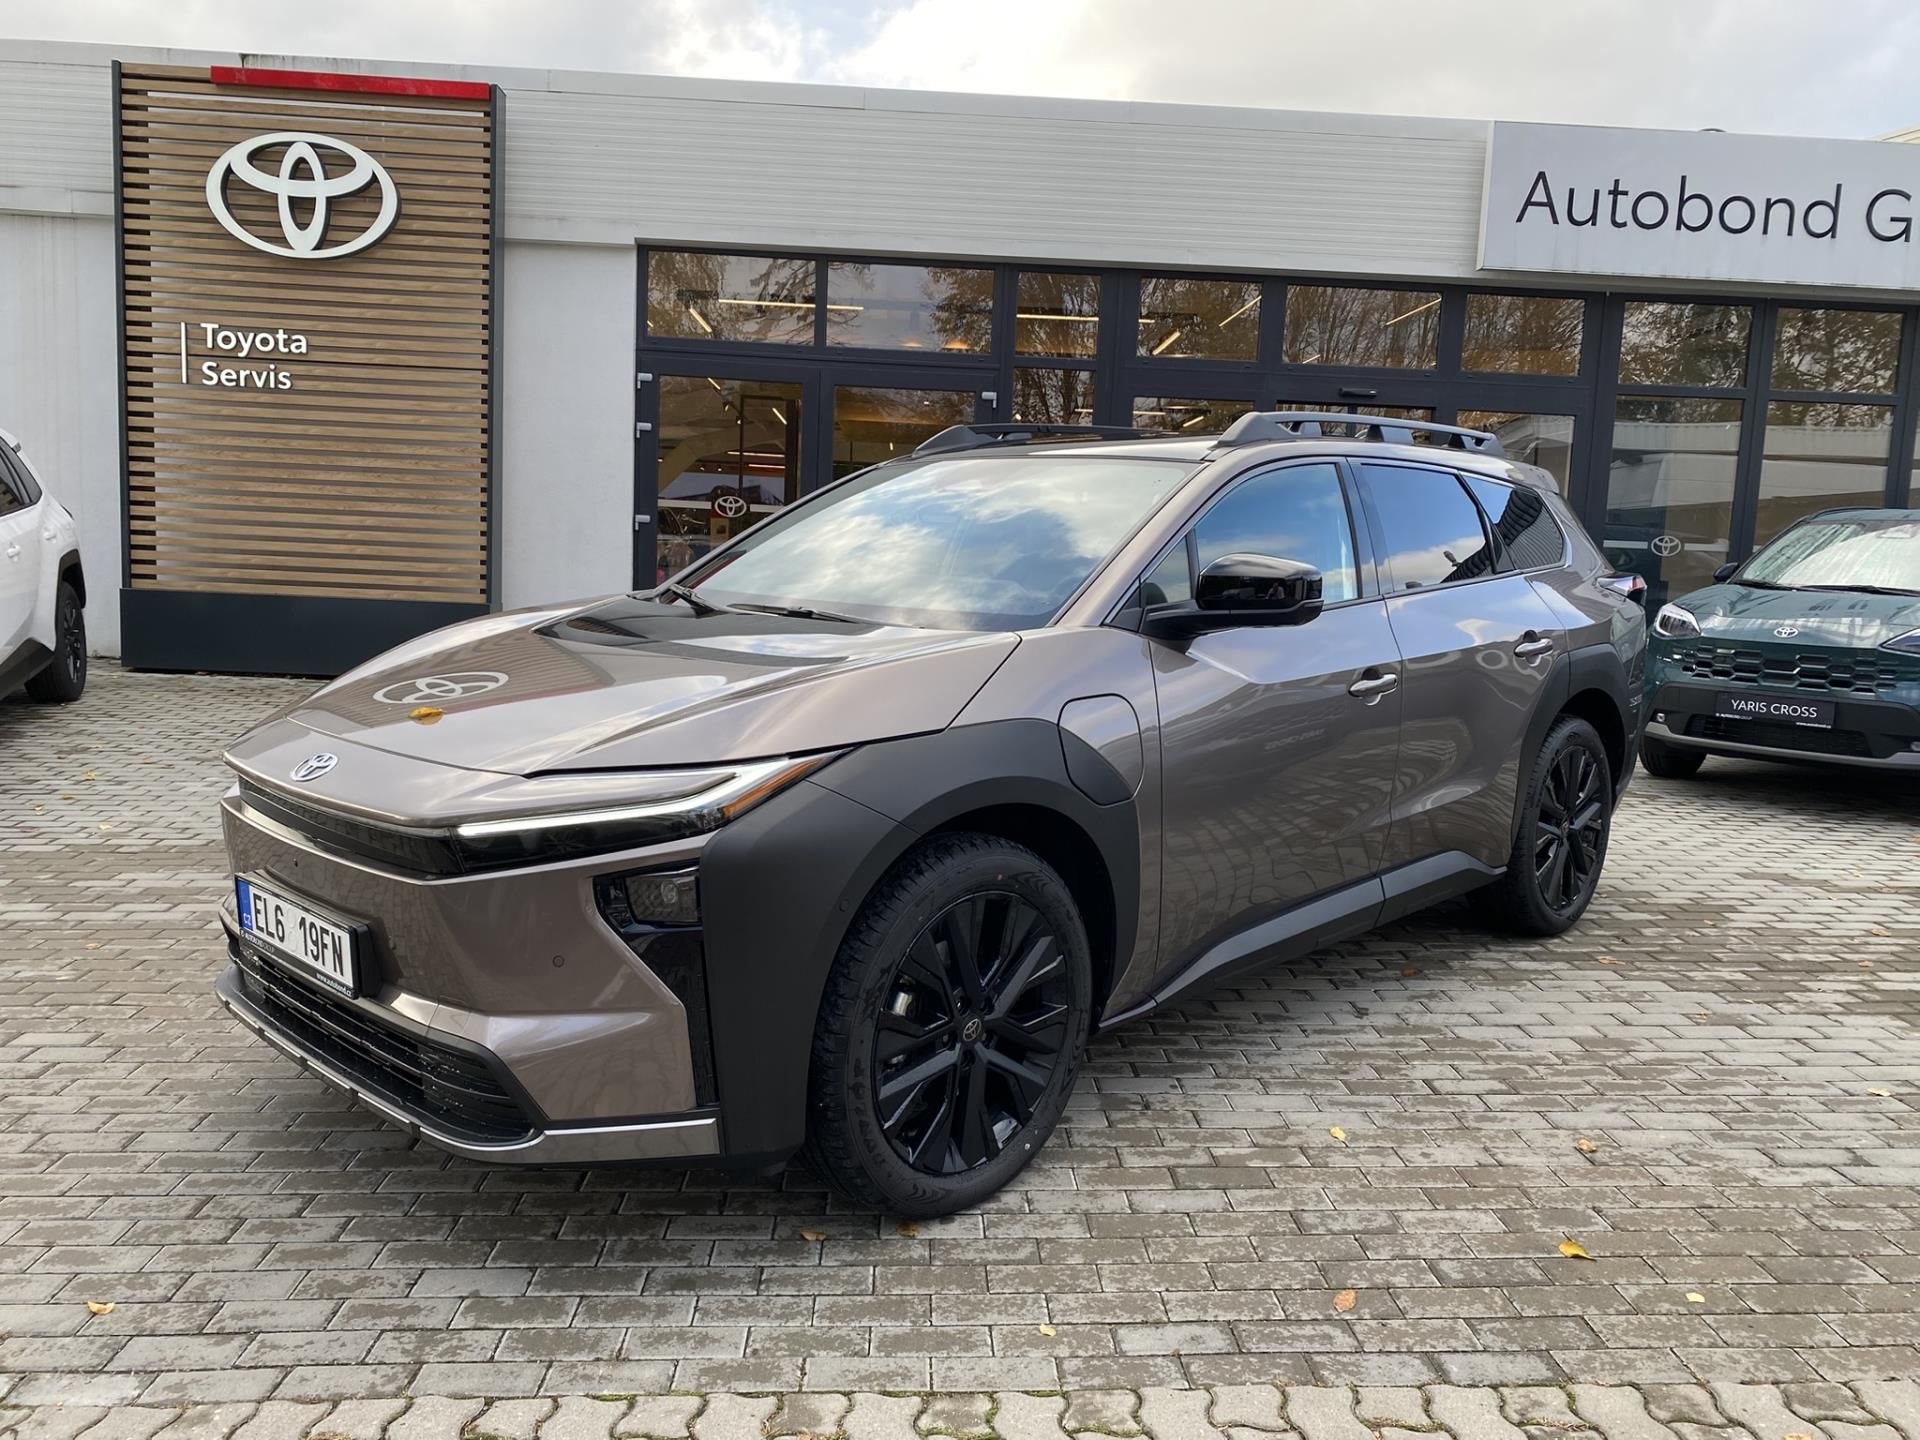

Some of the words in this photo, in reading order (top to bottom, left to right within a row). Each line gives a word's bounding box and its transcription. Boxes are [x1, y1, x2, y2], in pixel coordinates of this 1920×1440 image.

[1515, 170, 1843, 240] Autobond
[1865, 188, 1913, 243] G
[200, 322, 309, 357] Toyota
[201, 360, 293, 390] Servis
[1731, 699, 1767, 713] YARIS
[1770, 703, 1818, 718] CROSS
[252, 893, 285, 943] EL6
[299, 916, 344, 977] 19FN
